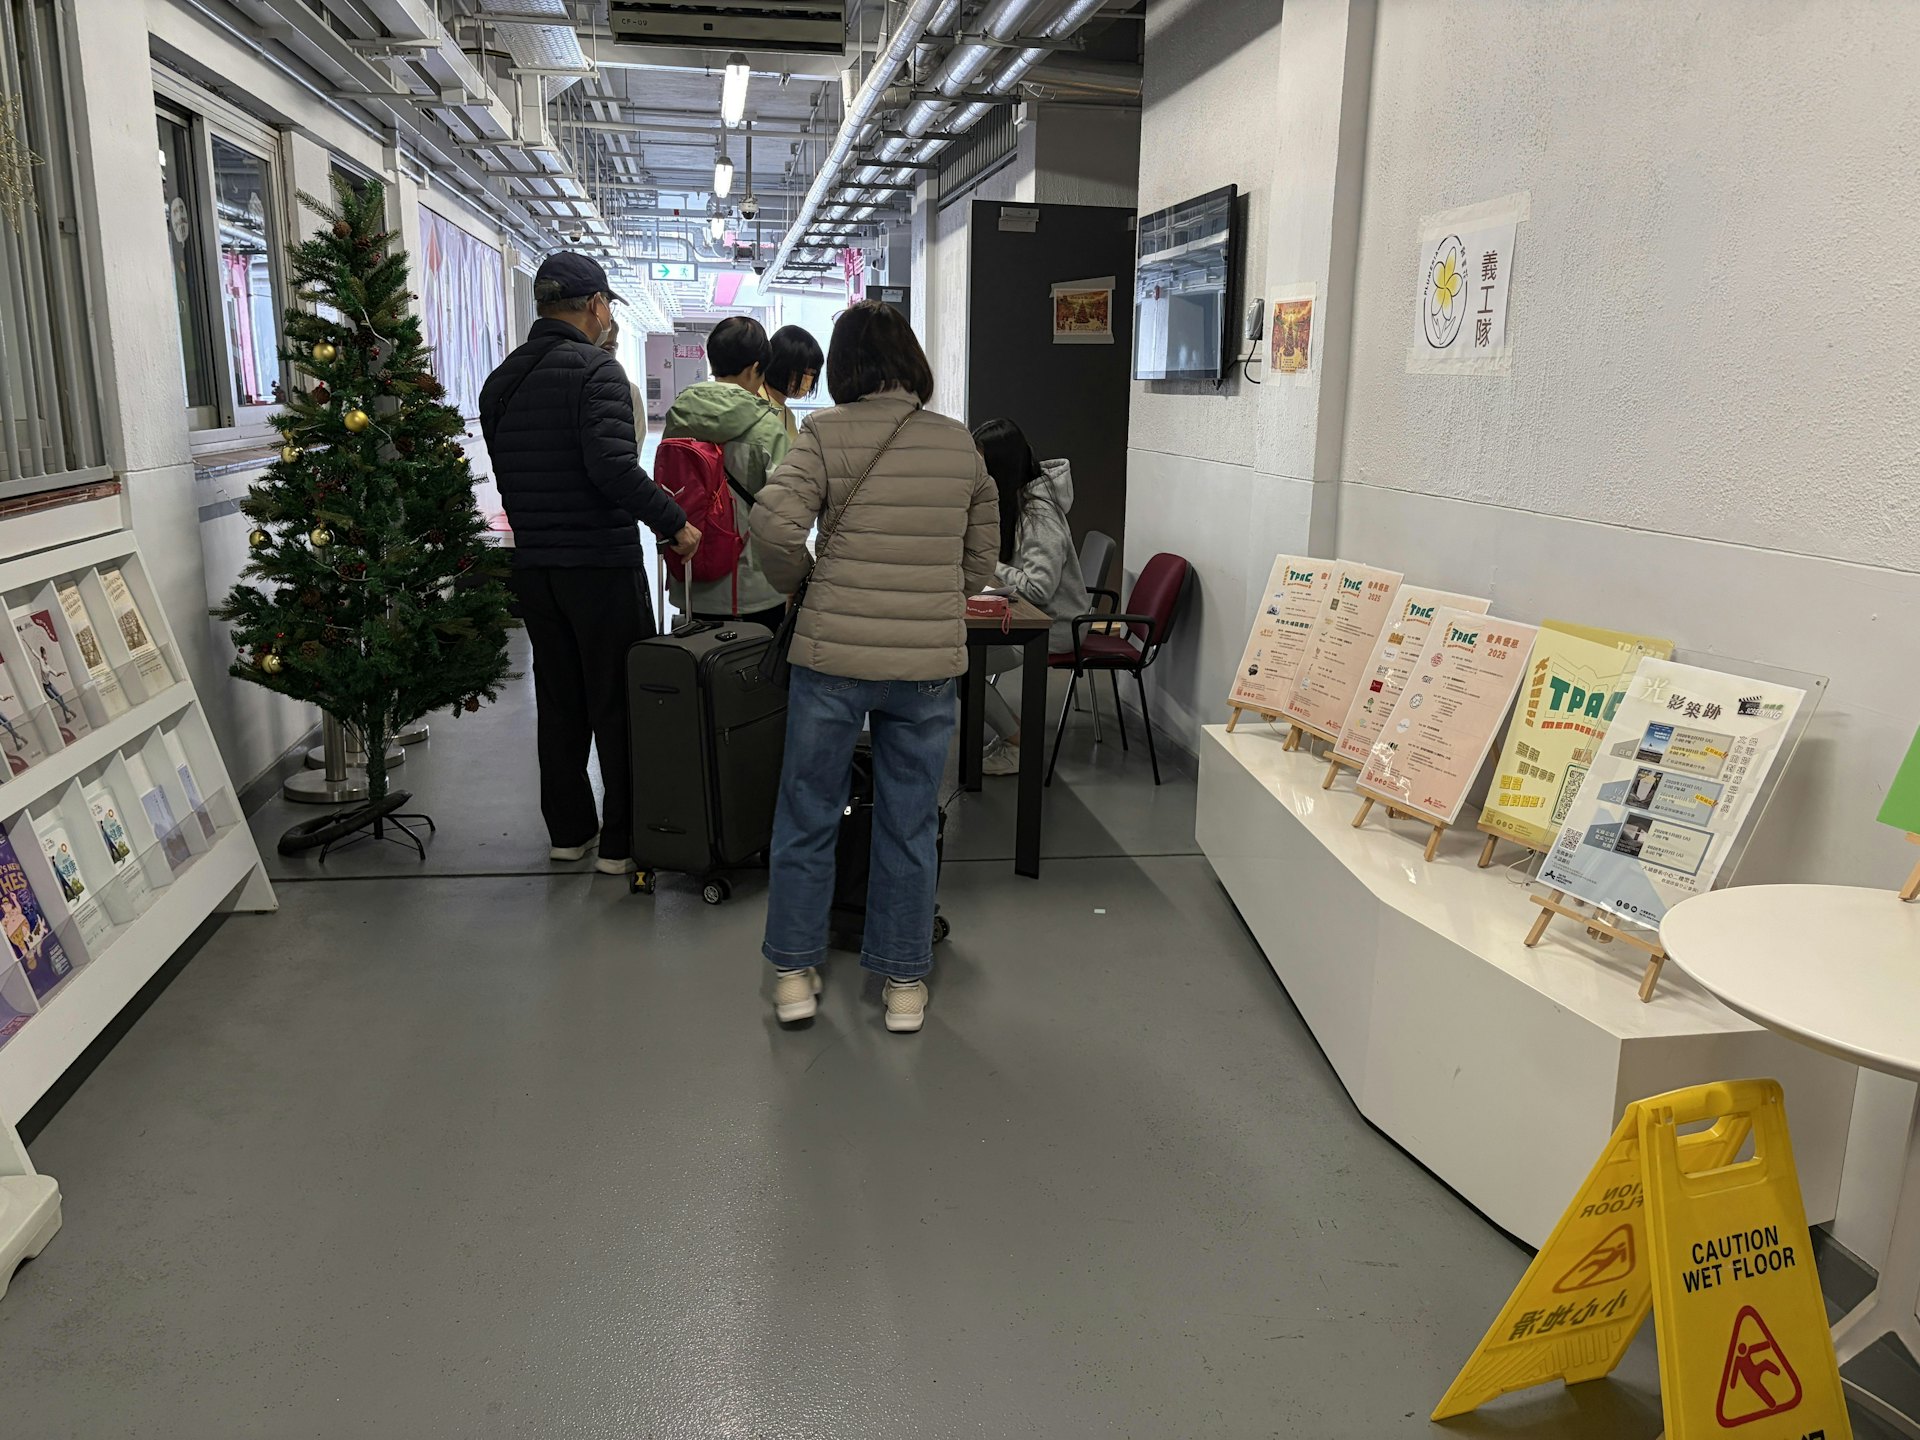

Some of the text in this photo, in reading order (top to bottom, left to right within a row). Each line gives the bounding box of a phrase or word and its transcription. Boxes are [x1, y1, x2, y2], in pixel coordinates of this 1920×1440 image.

[1475, 250, 1498, 348] 義工隊
[1290, 570, 1314, 582] TPAC
[1343, 577, 1363, 591] TPAC
[1409, 603, 1434, 618] TPAC
[1450, 628, 1478, 645] TPAC
[1487, 648, 1507, 660] 2025
[1550, 676, 1626, 722] TPAC
[1745, 707, 1783, 720] SCREENING
[1692, 1225, 1779, 1265] CAUTION
[1682, 1247, 1796, 1293] WET FLOOR
